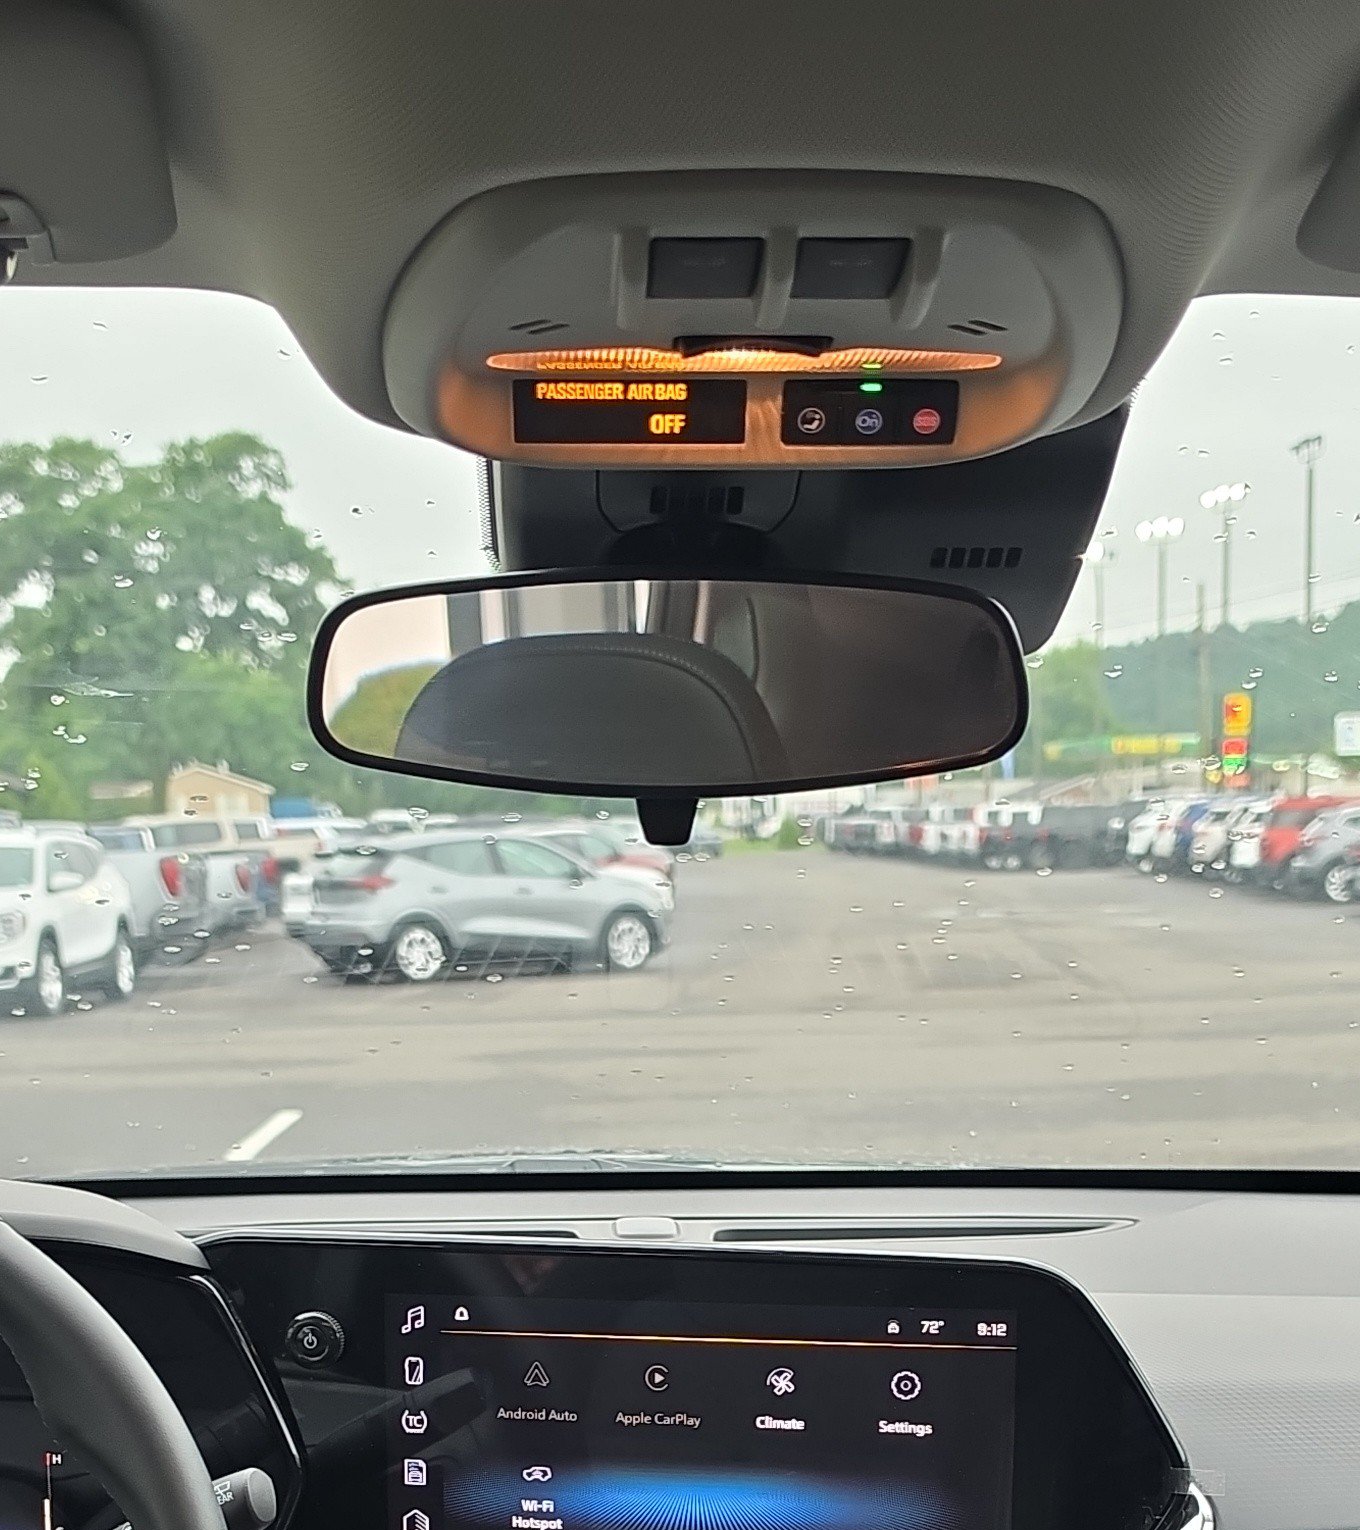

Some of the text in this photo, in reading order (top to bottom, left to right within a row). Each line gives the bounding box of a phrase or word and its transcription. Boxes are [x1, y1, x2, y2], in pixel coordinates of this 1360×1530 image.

[536, 383, 688, 400] PASSENGER AIR BAG
[649, 413, 686, 434] OFF
[920, 1320, 1007, 1337] 72° 9:12
[407, 1415, 422, 1428] TC
[497, 1407, 578, 1422] Android Auto
[616, 1411, 702, 1429] Apple CarPlay
[755, 1415, 805, 1431] Climate
[878, 1420, 933, 1437] Settings
[51, 1454, 62, 1464] H
[520, 1499, 555, 1513] Wi-Fi
[512, 1516, 564, 1530] Hotspot
